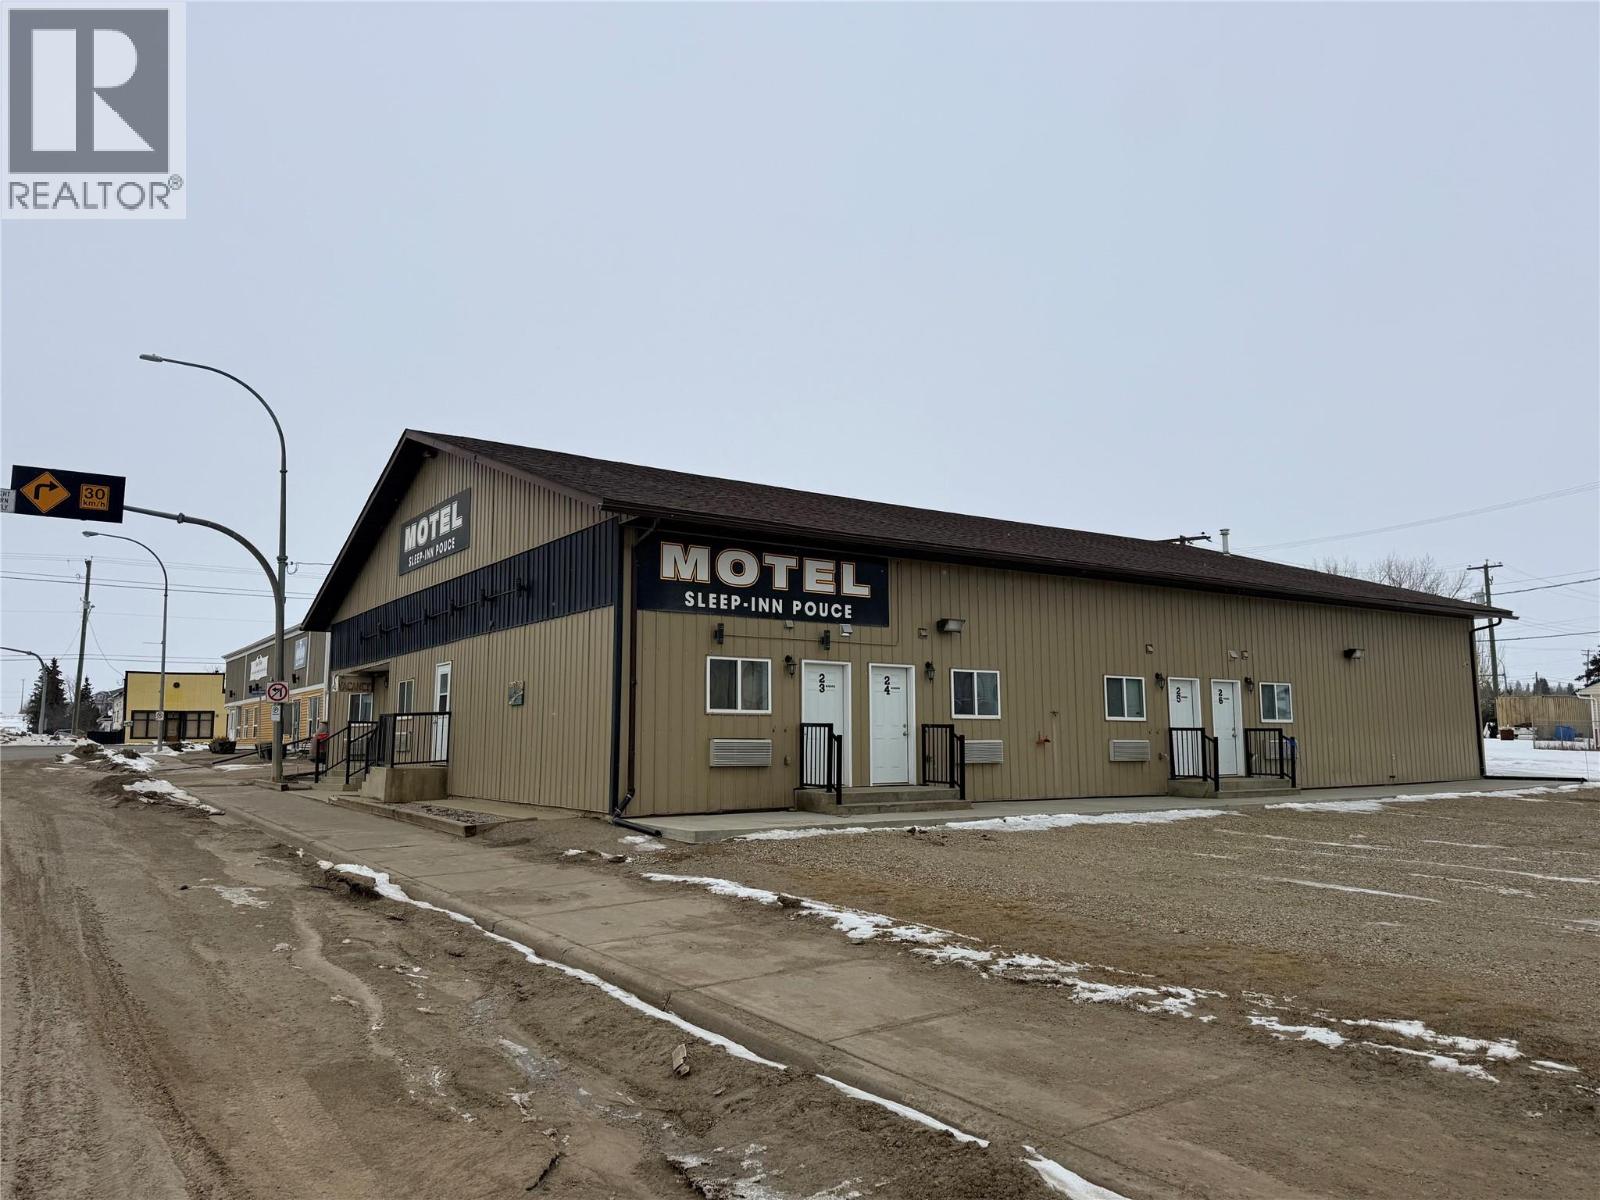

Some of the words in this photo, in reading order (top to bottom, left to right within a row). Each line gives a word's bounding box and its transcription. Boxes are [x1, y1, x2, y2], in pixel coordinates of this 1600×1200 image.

[82, 499, 106, 508] km/h
[84, 487, 106, 500] 30
[404, 500, 463, 553] MOTEL
[408, 546, 435, 568] SLEEP-INN
[435, 537, 456, 557] POUCE
[659, 541, 872, 598] MOTEL
[684, 591, 783, 615] SLEEP-INN
[792, 602, 853, 619] POUCE
